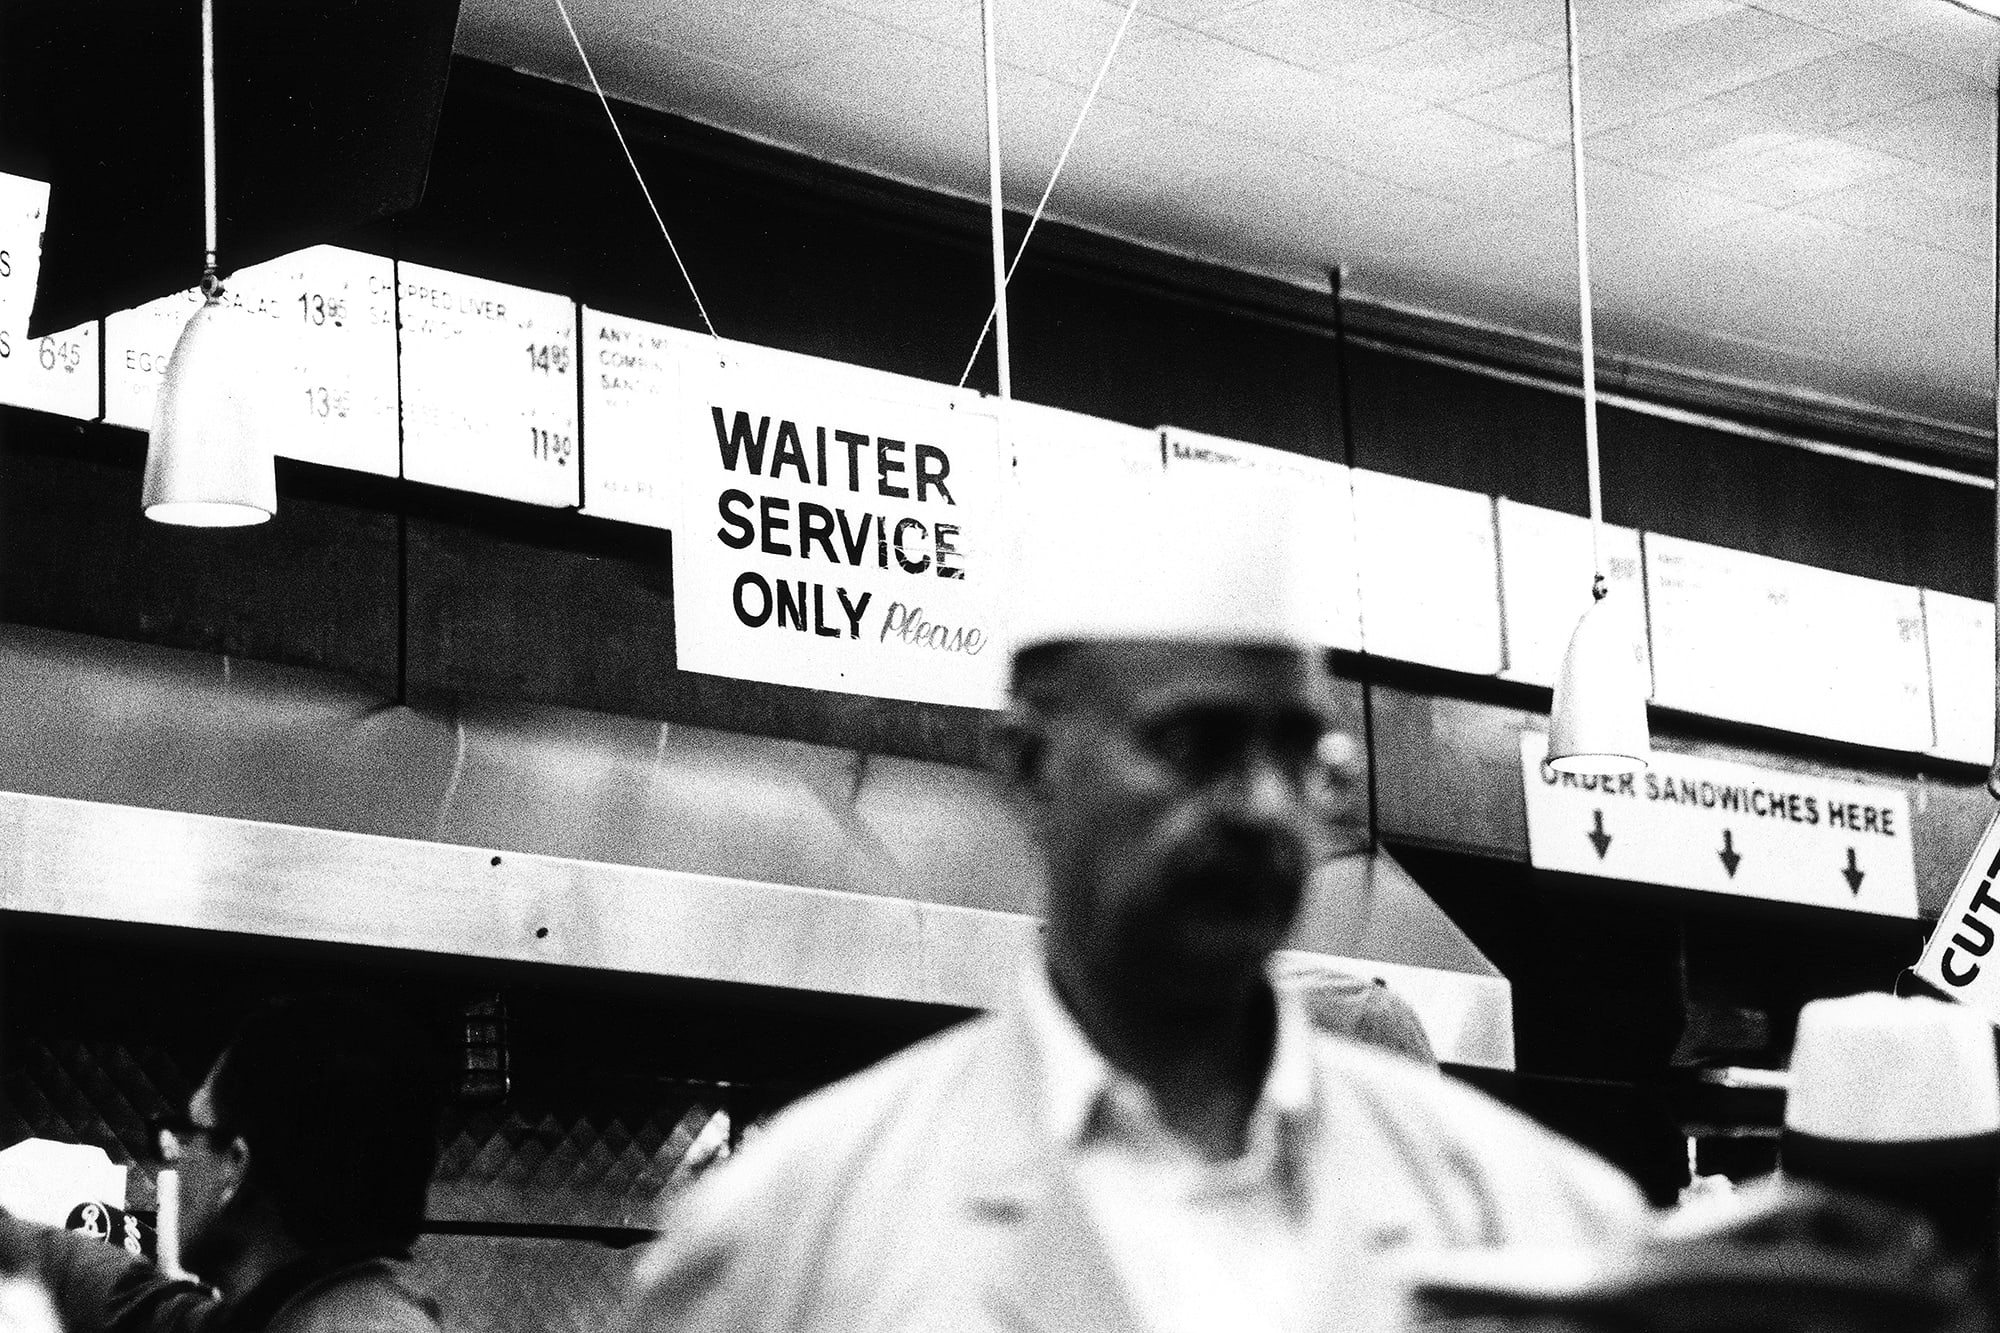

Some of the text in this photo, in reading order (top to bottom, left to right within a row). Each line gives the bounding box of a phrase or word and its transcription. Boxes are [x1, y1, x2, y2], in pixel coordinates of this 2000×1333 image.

[459, 297, 508, 322] LIVER
[711, 406, 958, 506] WAITER
[717, 488, 966, 581] SERVICE
[732, 571, 990, 656] ONLY Please
[1646, 772, 1821, 825] SANDWICHES
[1827, 799, 1897, 836] HERE
